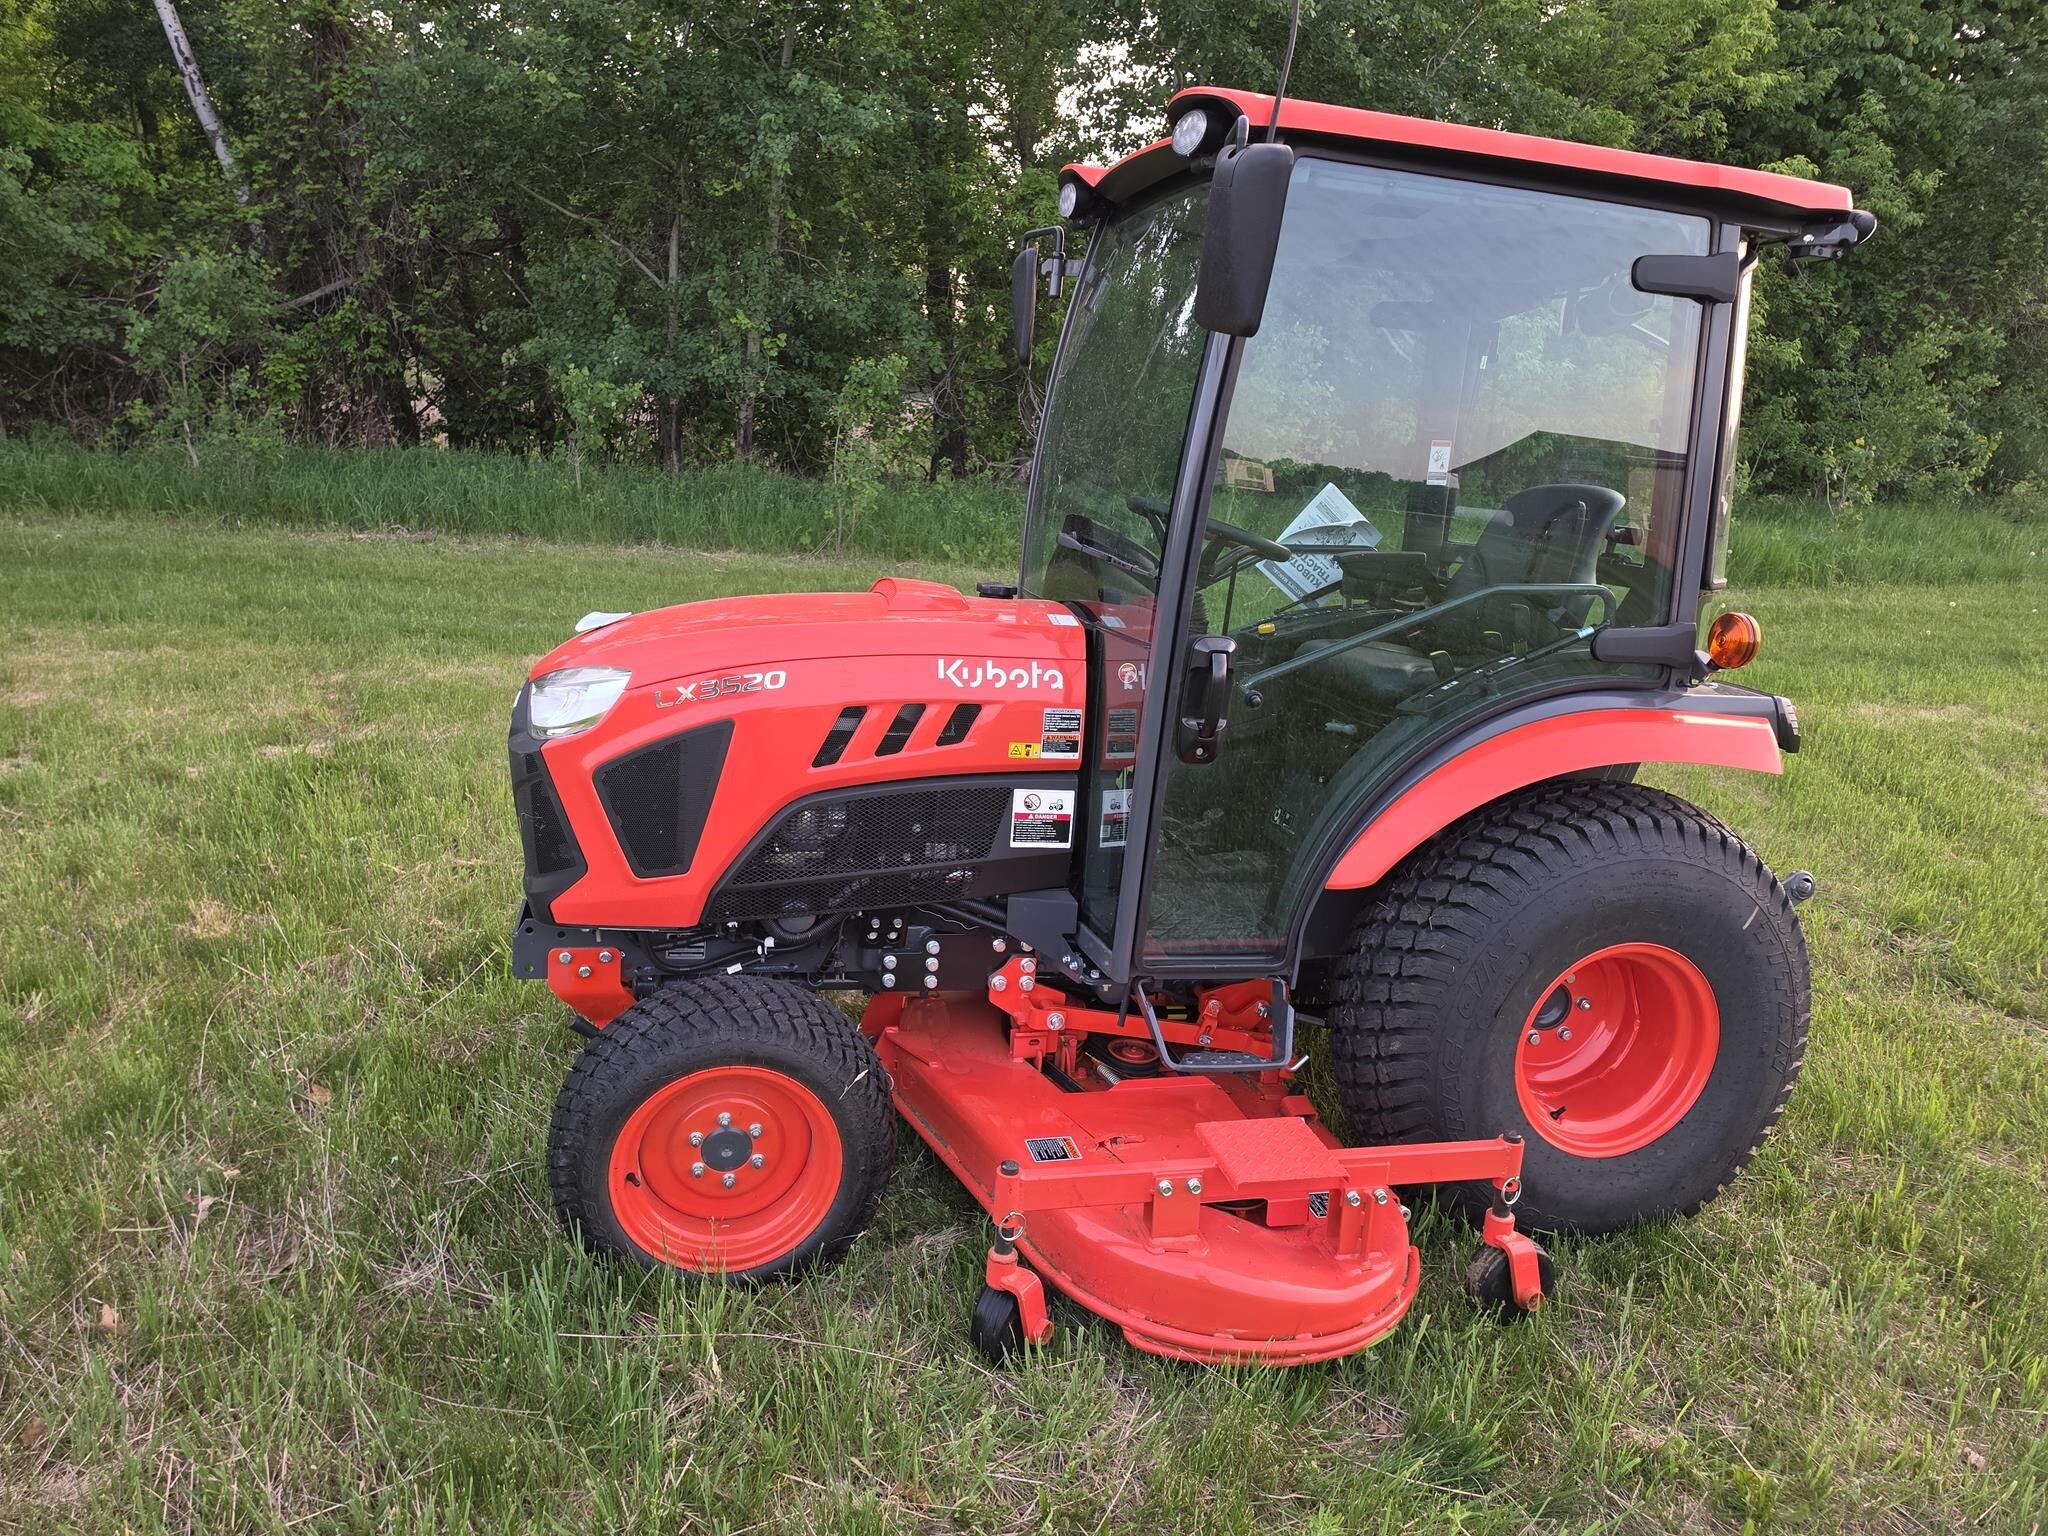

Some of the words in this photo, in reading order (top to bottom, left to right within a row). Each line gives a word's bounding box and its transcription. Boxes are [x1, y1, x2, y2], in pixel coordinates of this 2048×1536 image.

[654, 670, 787, 708] LX3520
[937, 658, 1064, 689] Kubota
[1753, 920, 1794, 1074] TITAN
